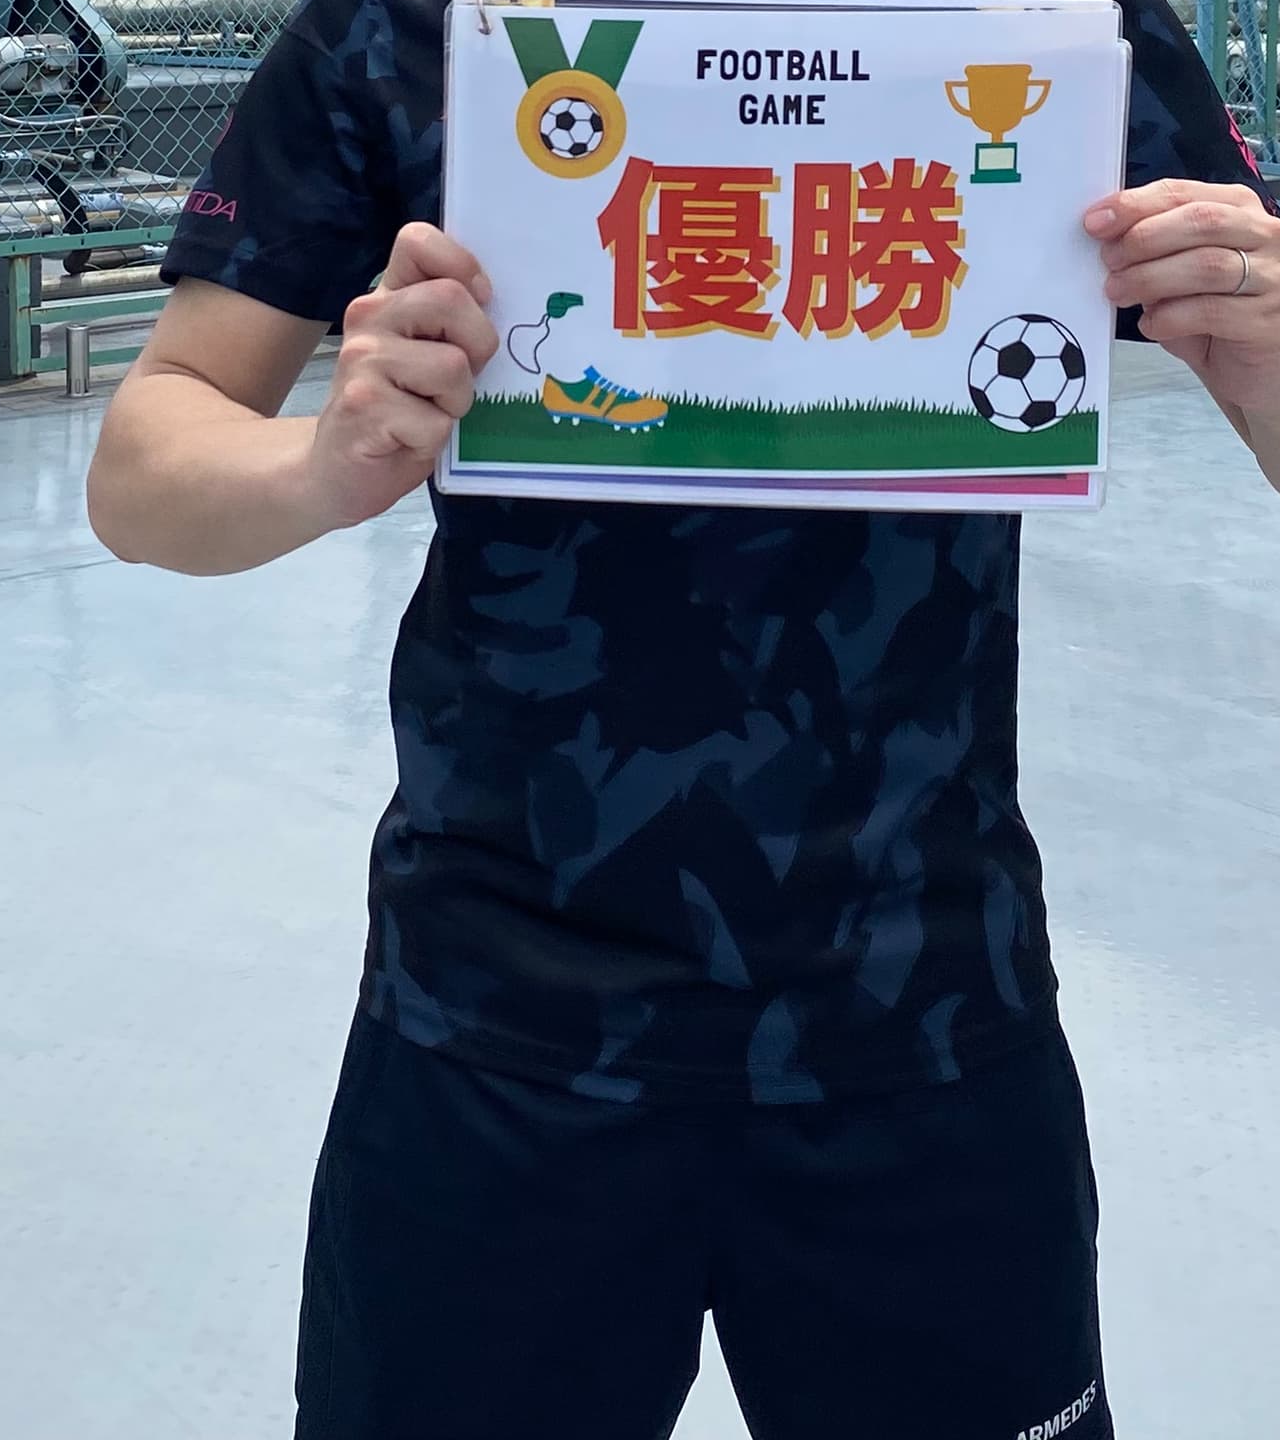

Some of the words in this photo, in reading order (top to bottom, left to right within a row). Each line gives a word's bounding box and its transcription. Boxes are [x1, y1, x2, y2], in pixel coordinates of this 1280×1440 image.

[696, 48, 871, 82] FOOTBALL
[738, 94, 826, 126] GAME
[597, 155, 970, 342] 優勝
